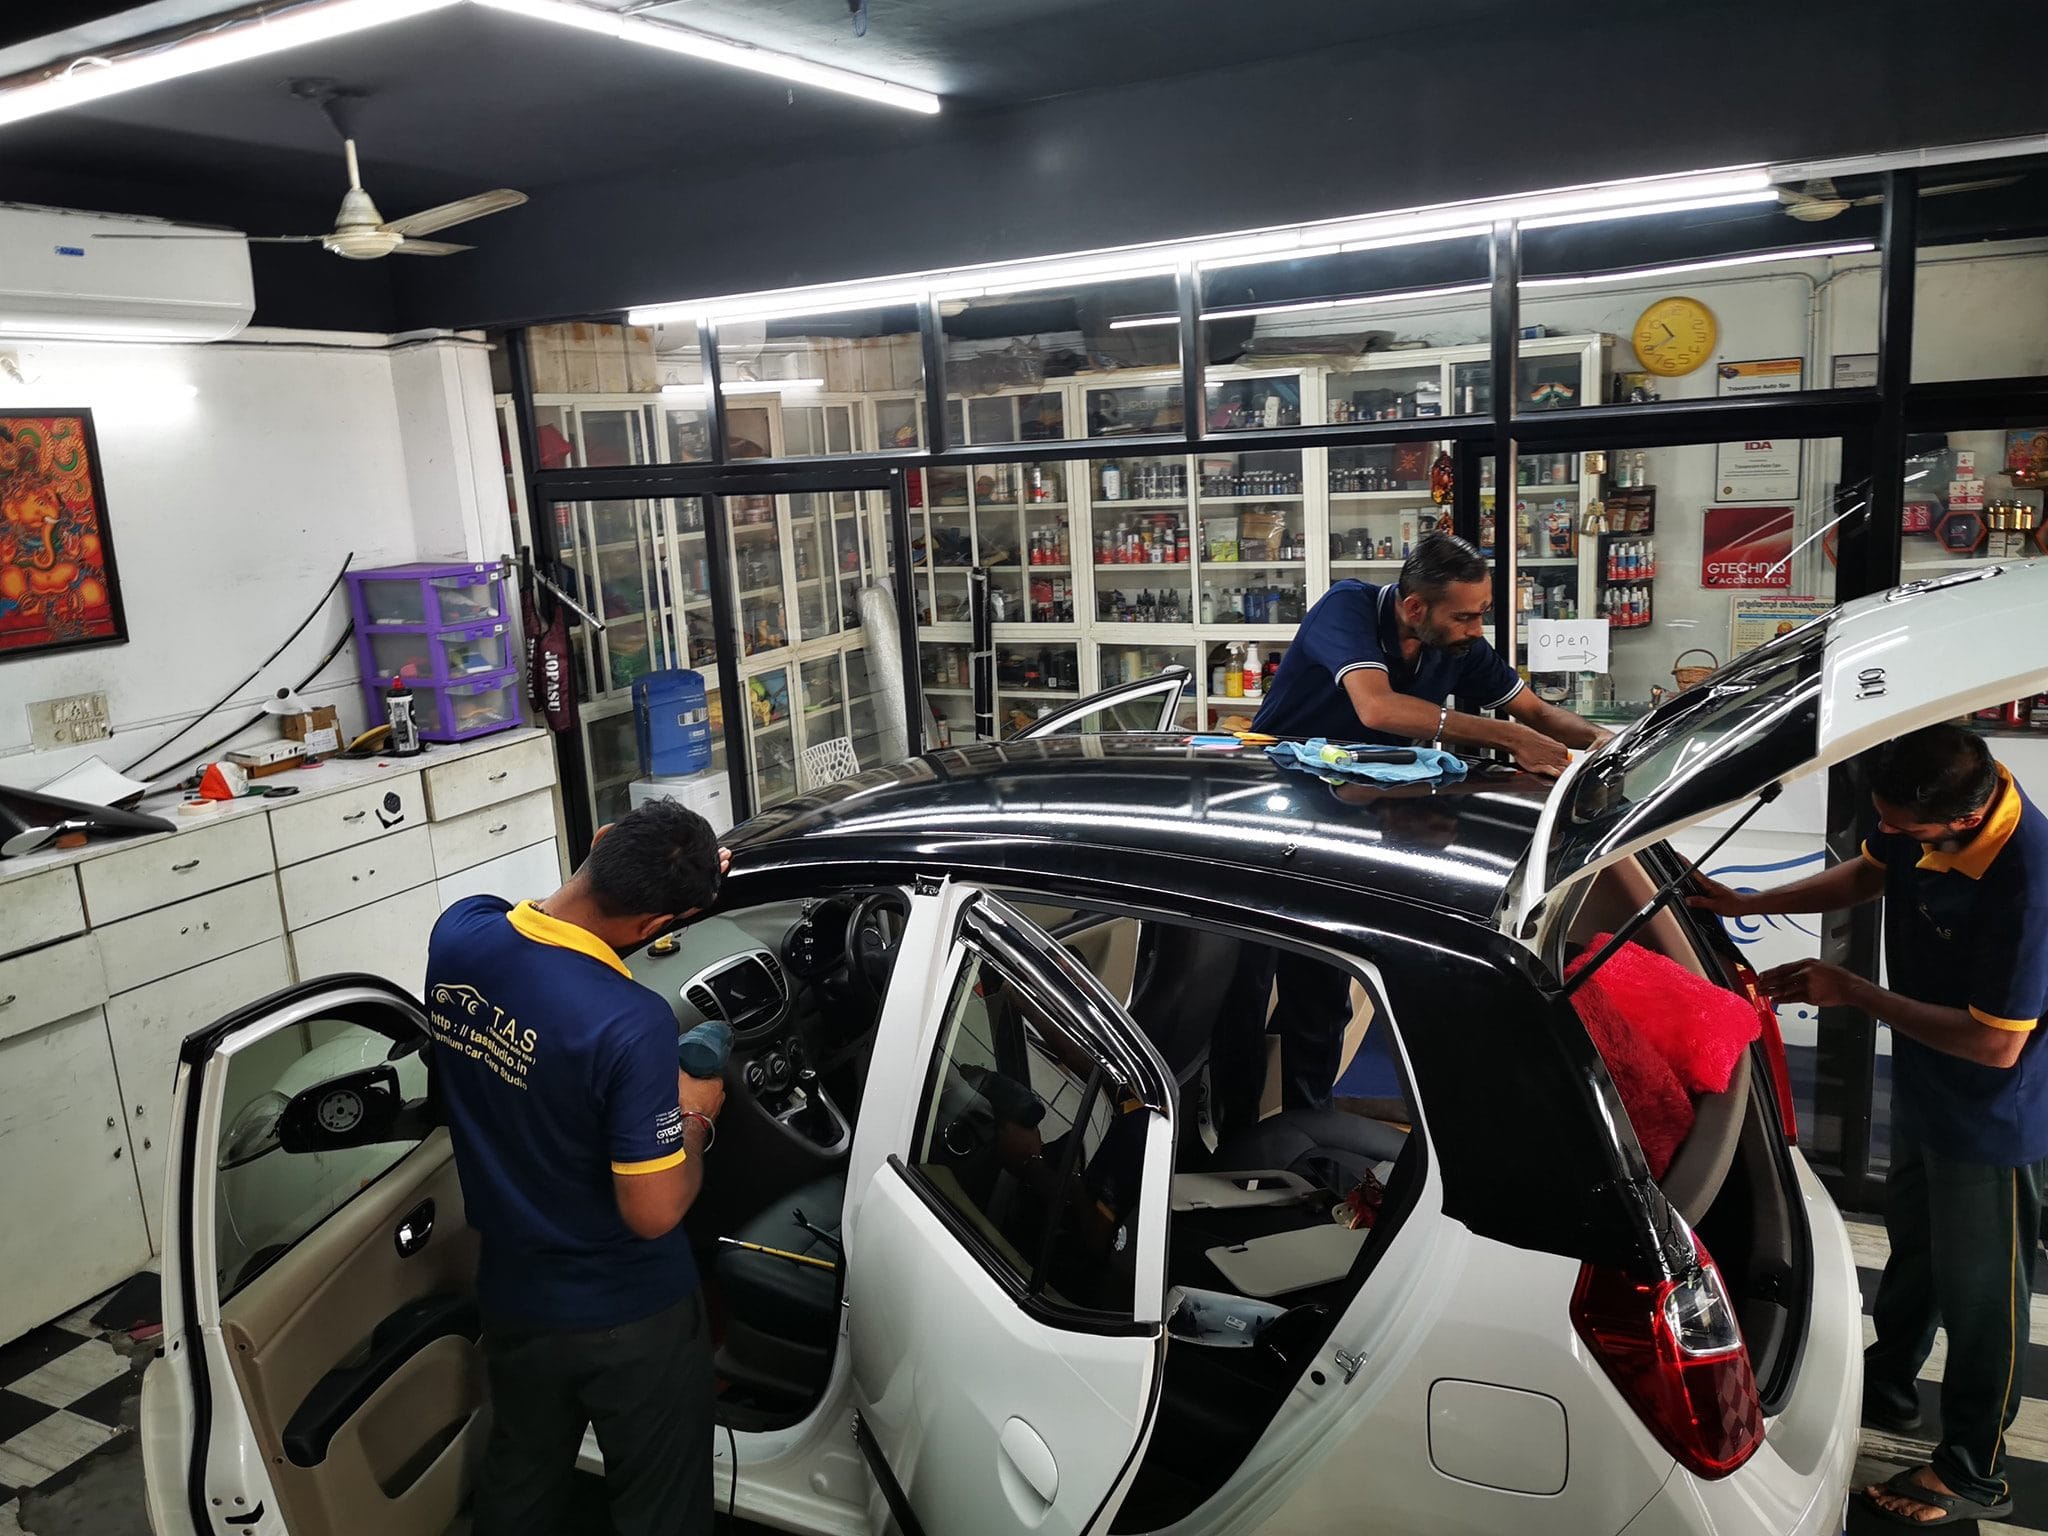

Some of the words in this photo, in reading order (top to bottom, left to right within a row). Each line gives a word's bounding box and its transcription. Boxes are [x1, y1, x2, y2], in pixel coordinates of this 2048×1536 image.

[1744, 441, 1773, 451] IDA
[1706, 562, 1787, 575] GTECHNIQ
[1719, 577, 1786, 585] ACCREDITED
[544, 651, 561, 712] JOPASU
[493, 1005, 538, 1053] T.A.S
[464, 1044, 483, 1060] Car
[500, 1066, 528, 1091] Studio
